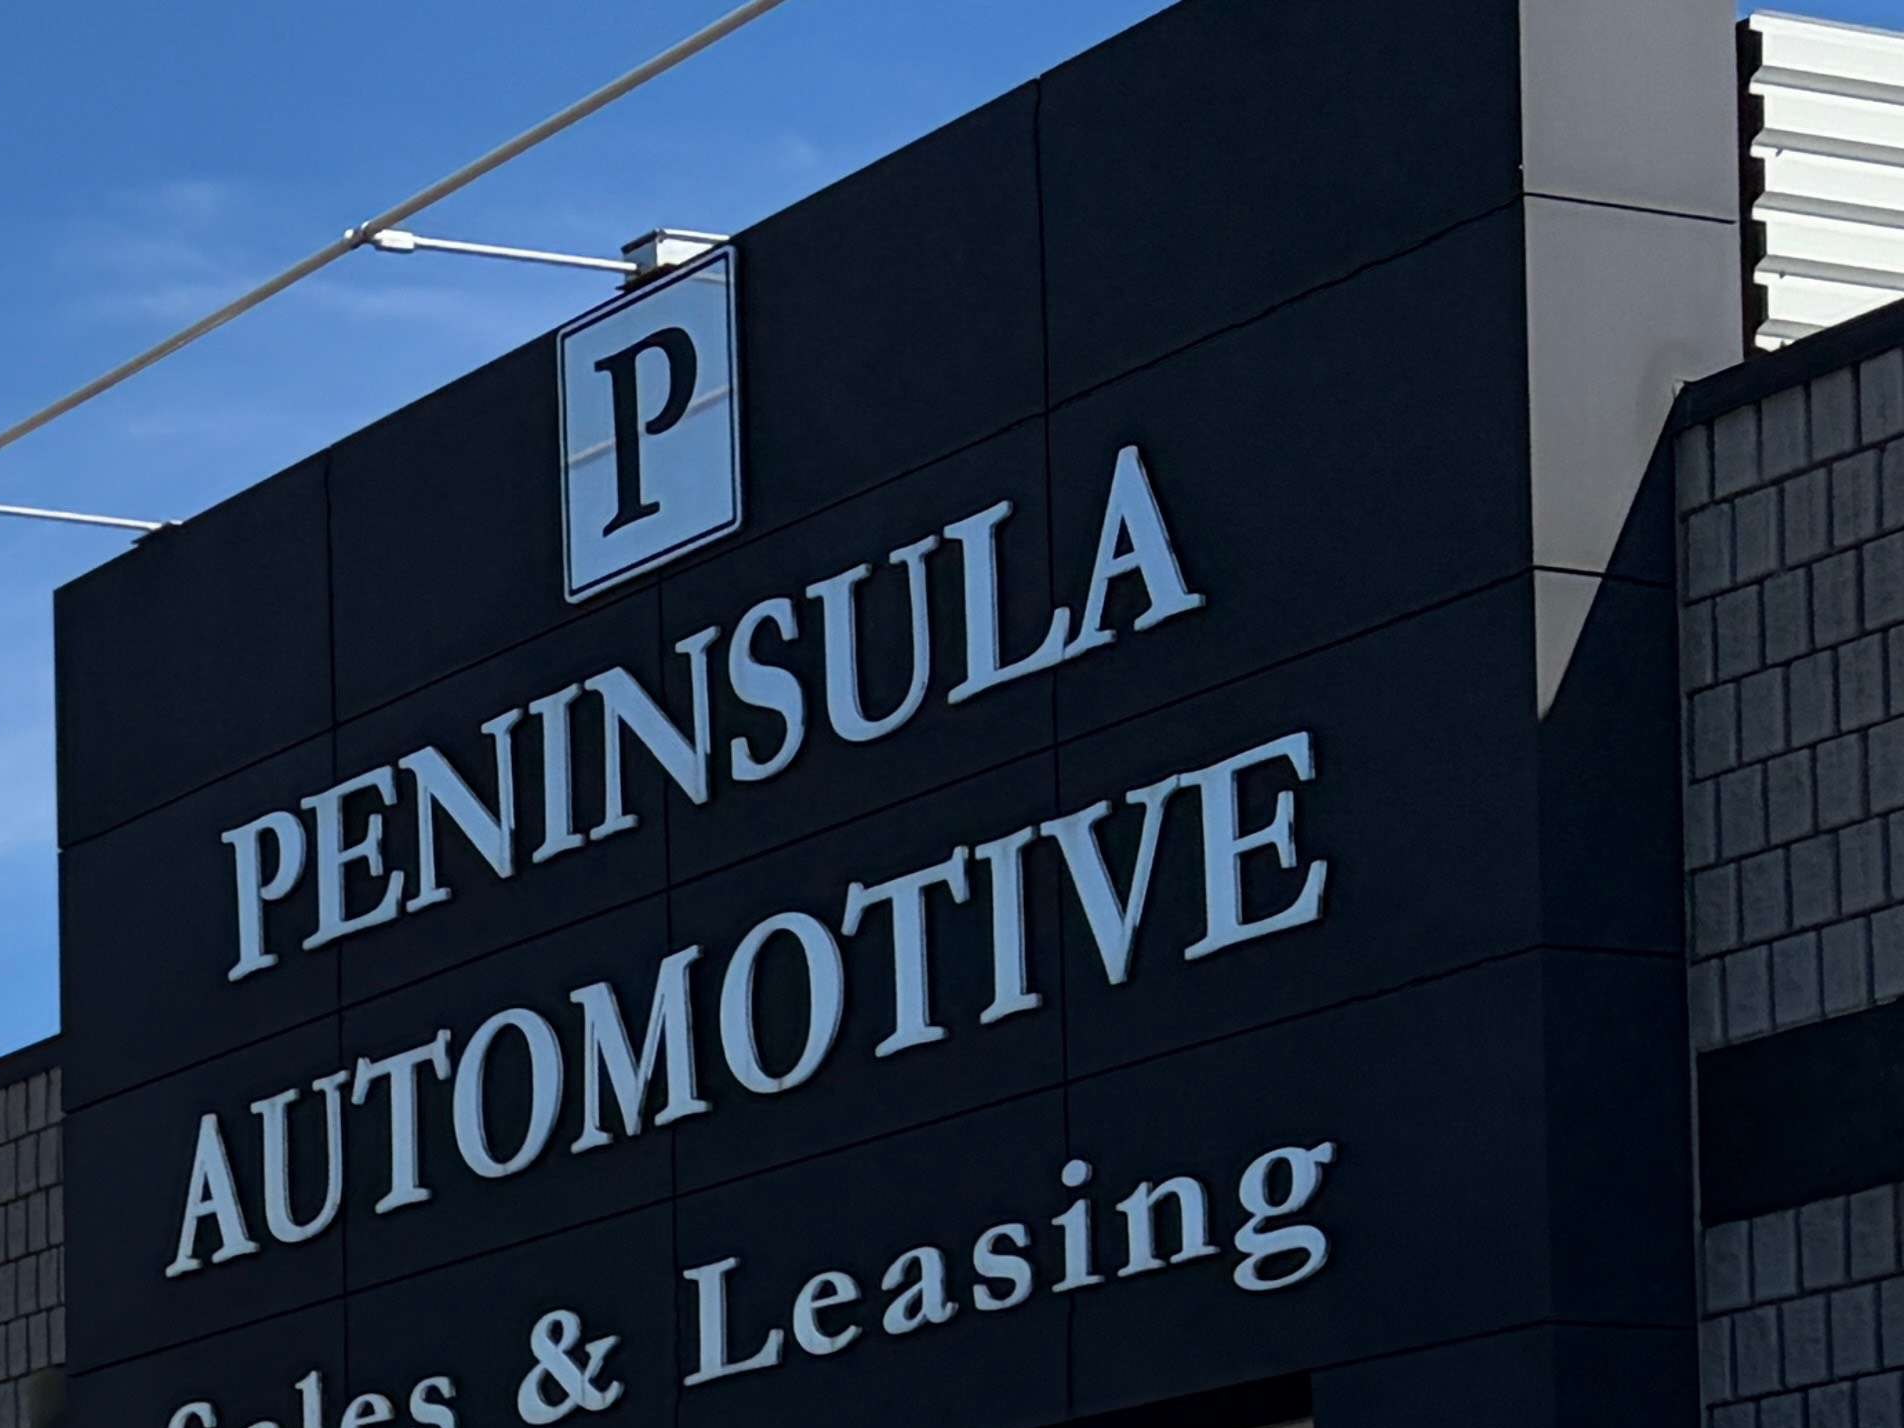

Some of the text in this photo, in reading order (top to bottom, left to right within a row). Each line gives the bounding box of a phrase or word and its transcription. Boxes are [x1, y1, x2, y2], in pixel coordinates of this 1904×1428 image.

[593, 326, 700, 538] P
[221, 445, 1206, 983] PENINSULA
[164, 730, 1329, 1279] AUTOMOTIVE
[516, 1308, 622, 1427] &
[682, 1141, 1334, 1388] Leasing
